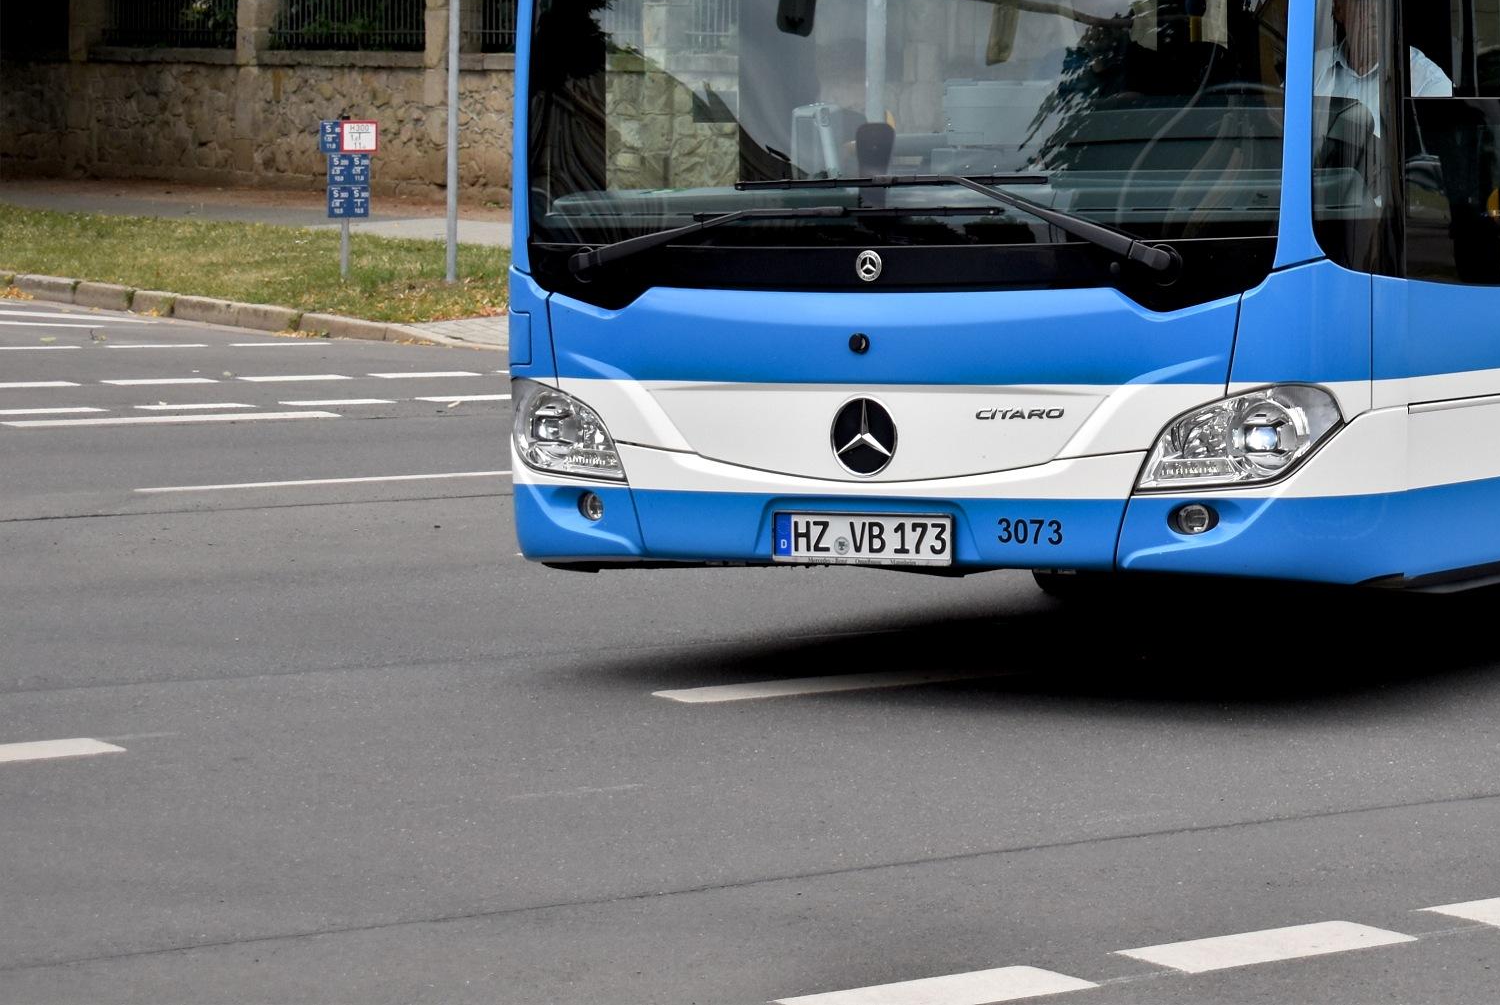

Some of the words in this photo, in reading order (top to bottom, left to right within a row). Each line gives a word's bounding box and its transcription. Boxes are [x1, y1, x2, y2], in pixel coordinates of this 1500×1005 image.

[975, 408, 1065, 420] CITARO
[793, 520, 831, 552] HZ
[849, 521, 887, 554] VB
[893, 522, 947, 555] 173
[997, 517, 1063, 546] 3073
[780, 539, 787, 549] D
